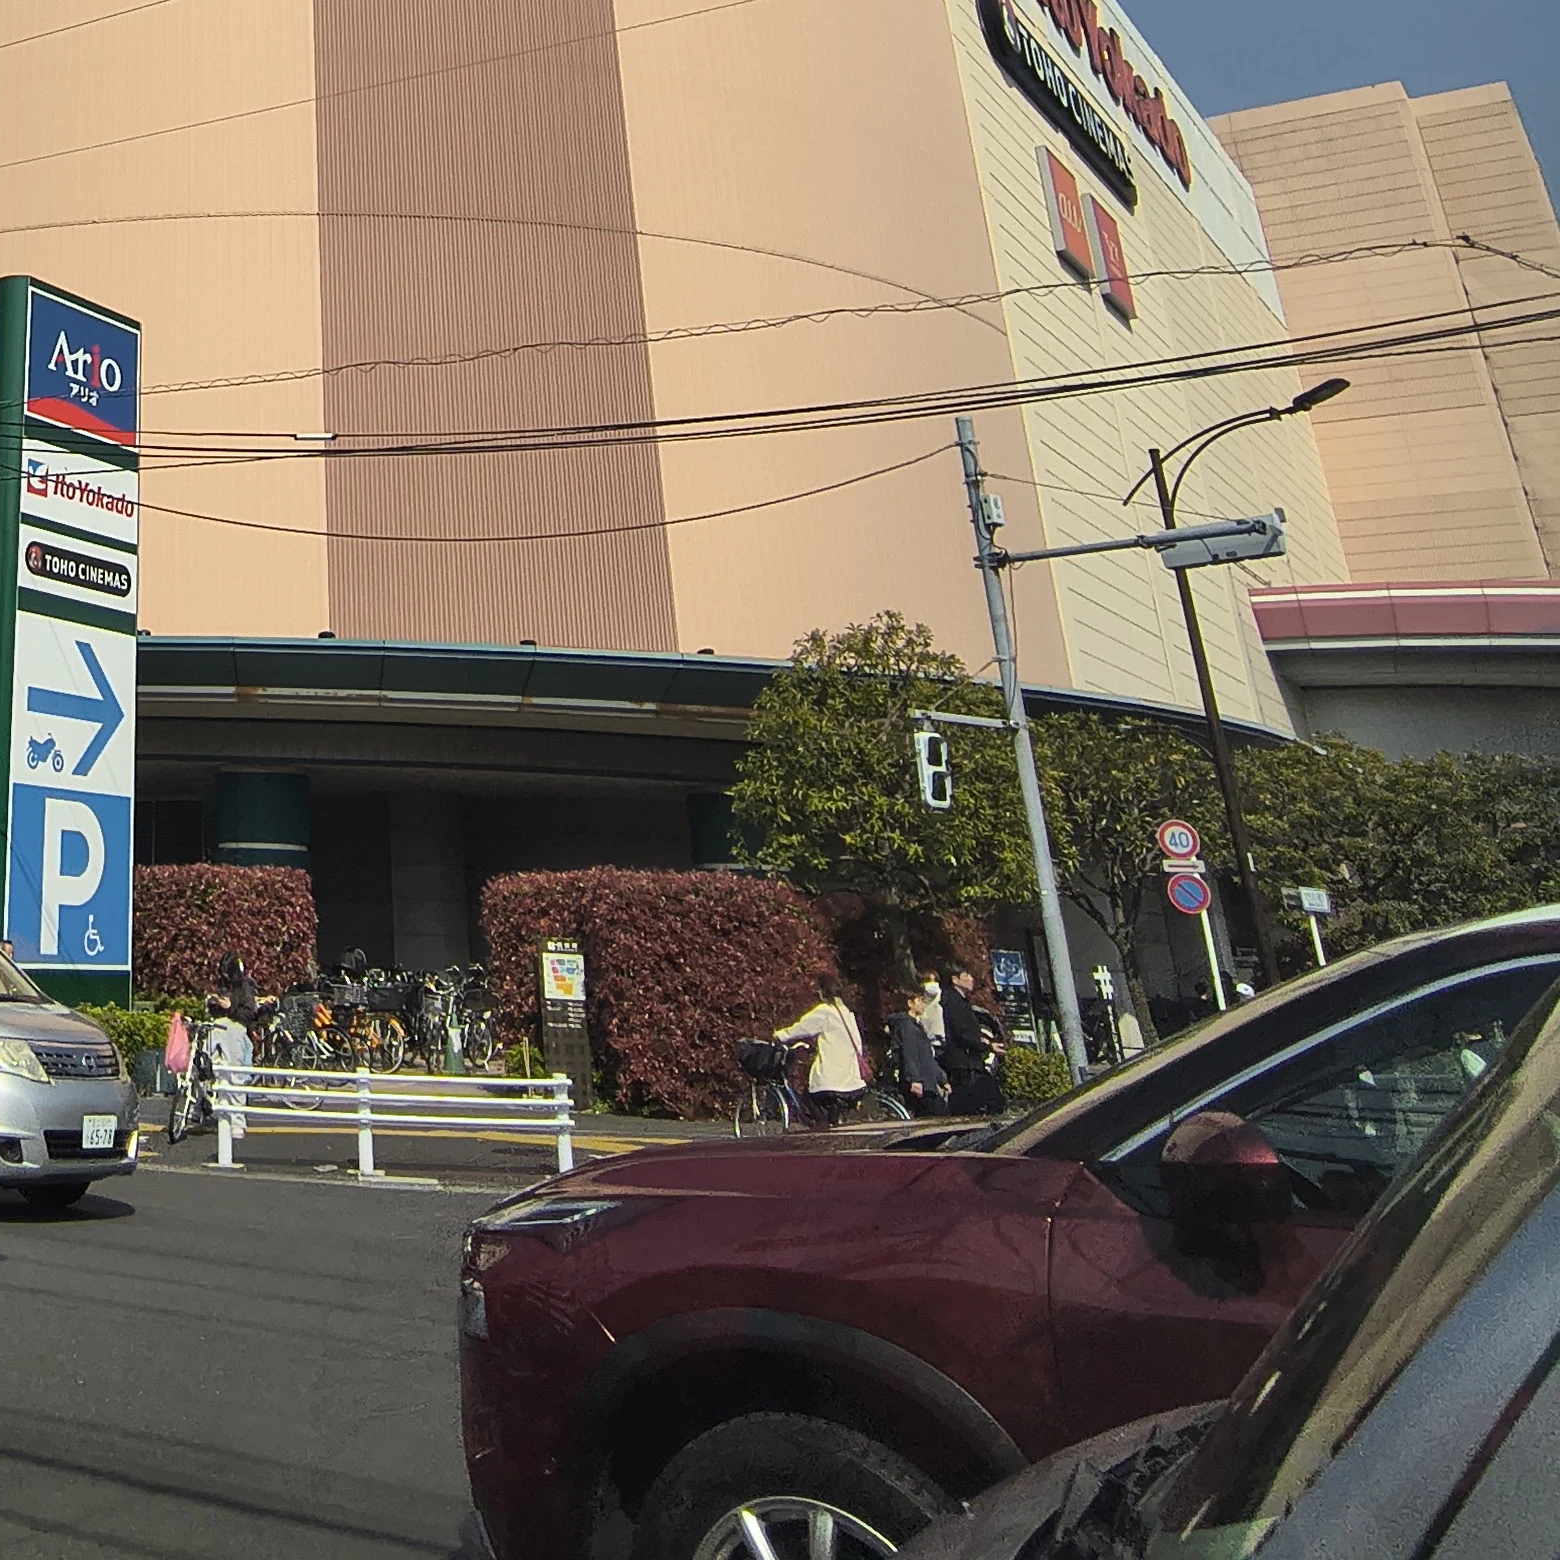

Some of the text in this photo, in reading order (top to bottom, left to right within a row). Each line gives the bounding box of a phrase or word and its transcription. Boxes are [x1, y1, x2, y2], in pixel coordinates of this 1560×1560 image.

[1018, 28, 1068, 108] TOHO
[47, 330, 122, 392] Ario
[69, 381, 100, 407] アリオ
[45, 553, 128, 591] TOHO CINEMAS
[1168, 831, 1190, 849] 40
[40, 796, 105, 956] P
